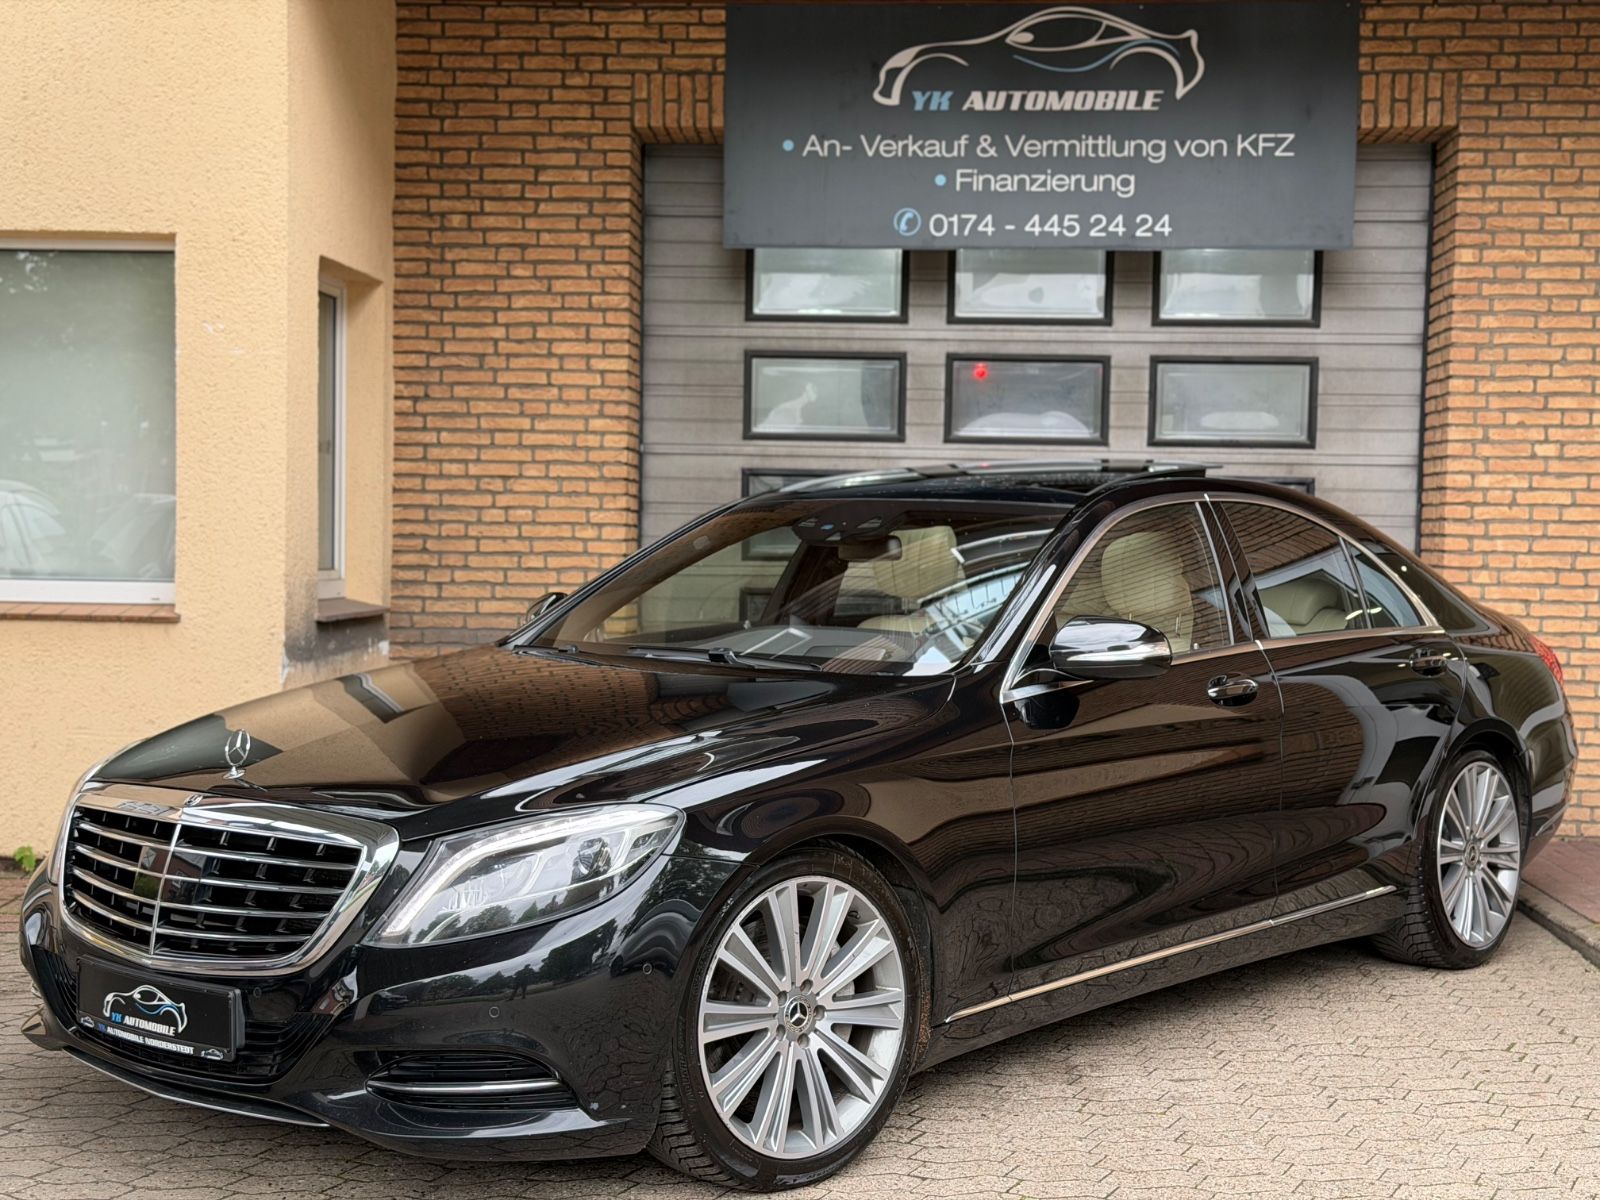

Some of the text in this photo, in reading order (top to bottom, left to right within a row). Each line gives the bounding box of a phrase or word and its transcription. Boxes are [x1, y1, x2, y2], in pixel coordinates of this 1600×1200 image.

[912, 90, 1164, 111] YK AUTOMOBILE
[802, 133, 1295, 164] An- Verkauf & Vermittlung von KFZ
[955, 168, 1136, 198] Finanzierung
[928, 213, 996, 237] 0174
[1024, 213, 1081, 237] 445
[1089, 213, 1127, 237] 24
[1135, 213, 1173, 237] 24
[106, 1026, 145, 1044] AUTOMOBILE
[111, 1012, 176, 1037] YK AUTOMOBILE
